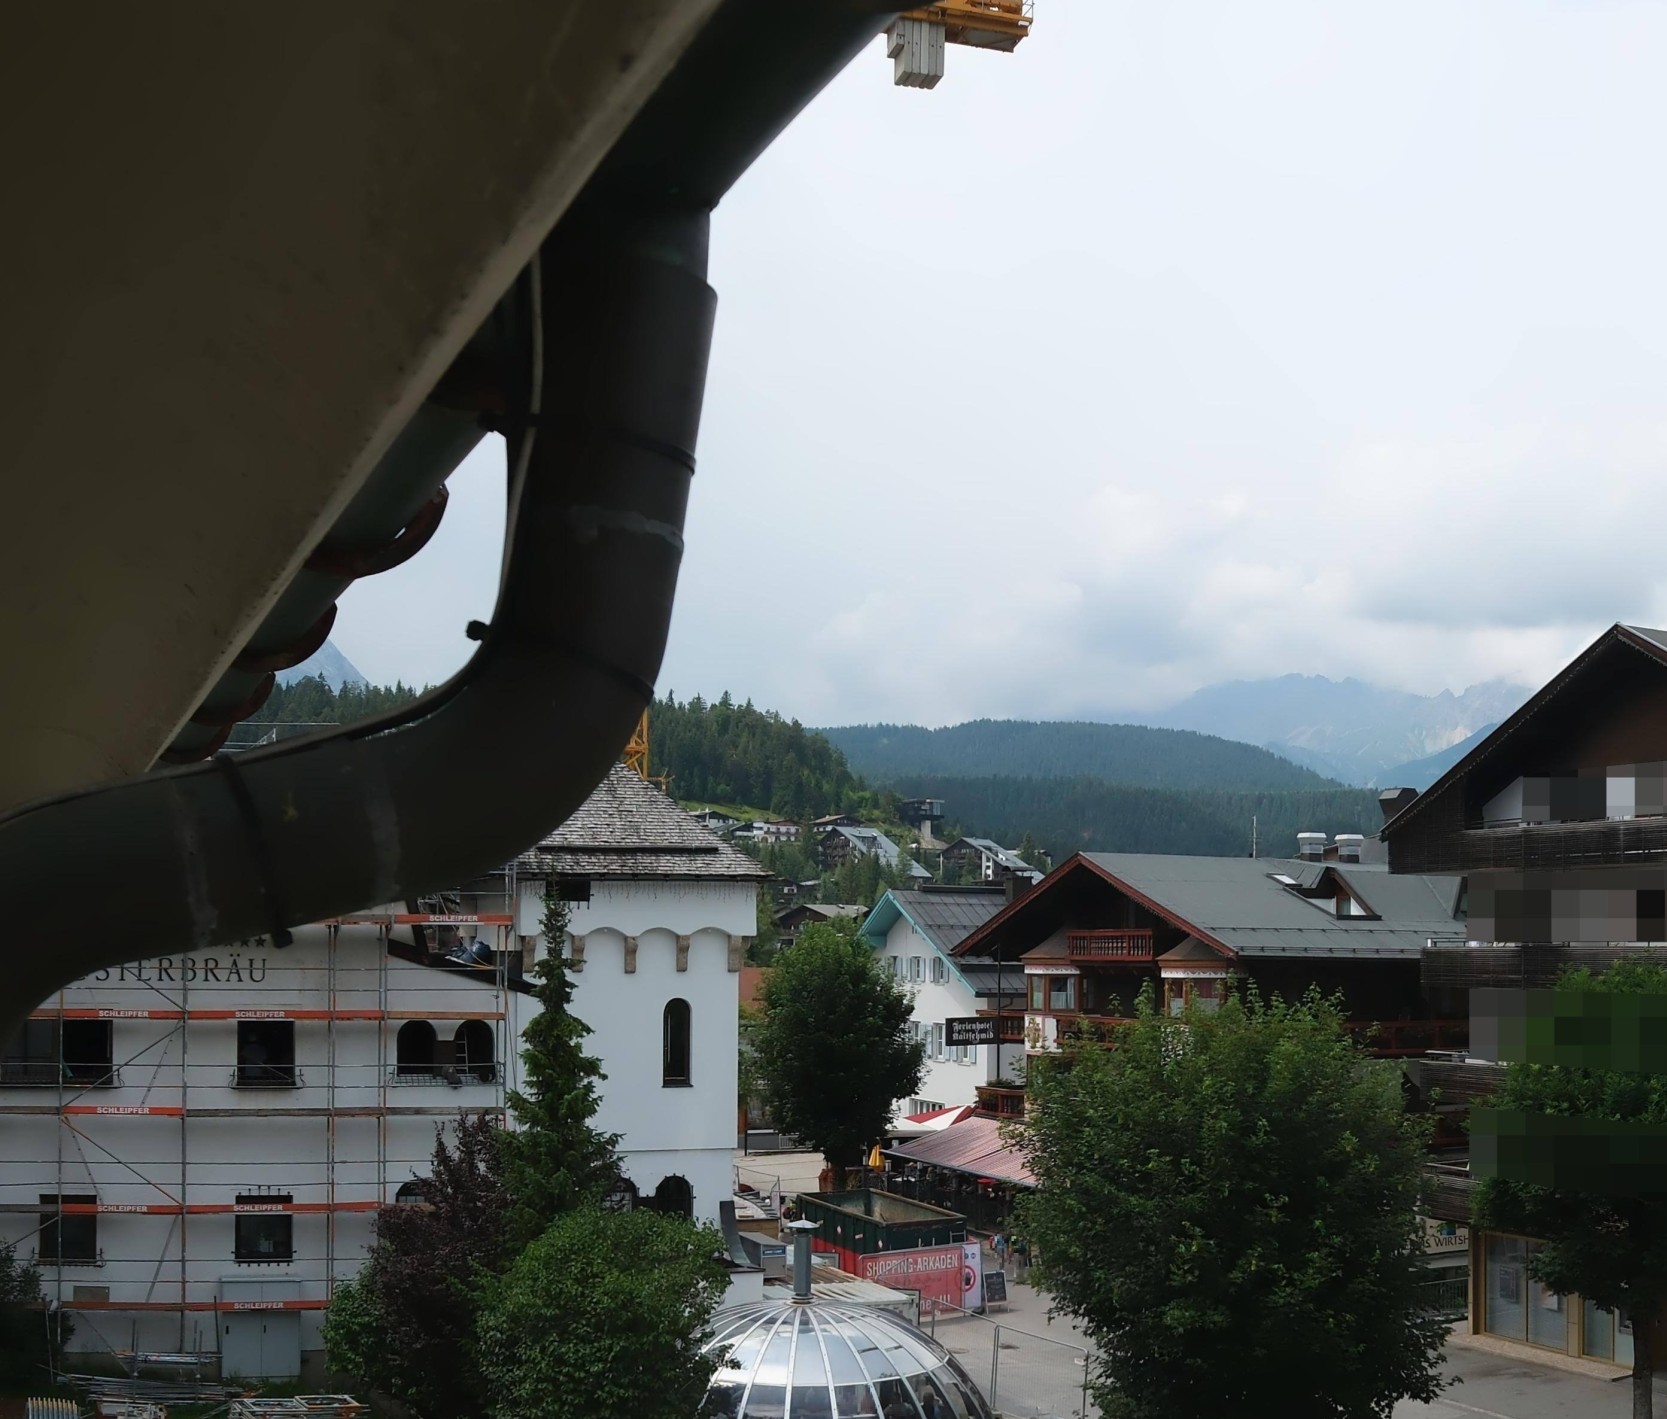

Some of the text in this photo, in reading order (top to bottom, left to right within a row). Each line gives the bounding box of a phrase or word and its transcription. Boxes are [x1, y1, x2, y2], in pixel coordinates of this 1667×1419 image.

[429, 915, 479, 923] SCHLEIPFER
[98, 1009, 149, 1018] SCHLEIPFER
[235, 1010, 285, 1018] SCHLEIPFER
[96, 1106, 150, 1115] SCHLEIPFER
[97, 1205, 148, 1213] SCHLEIPFER
[233, 1204, 283, 1212] SCHLEIPFER
[866, 1254, 958, 1278] SHOPPING-ARKADEN
